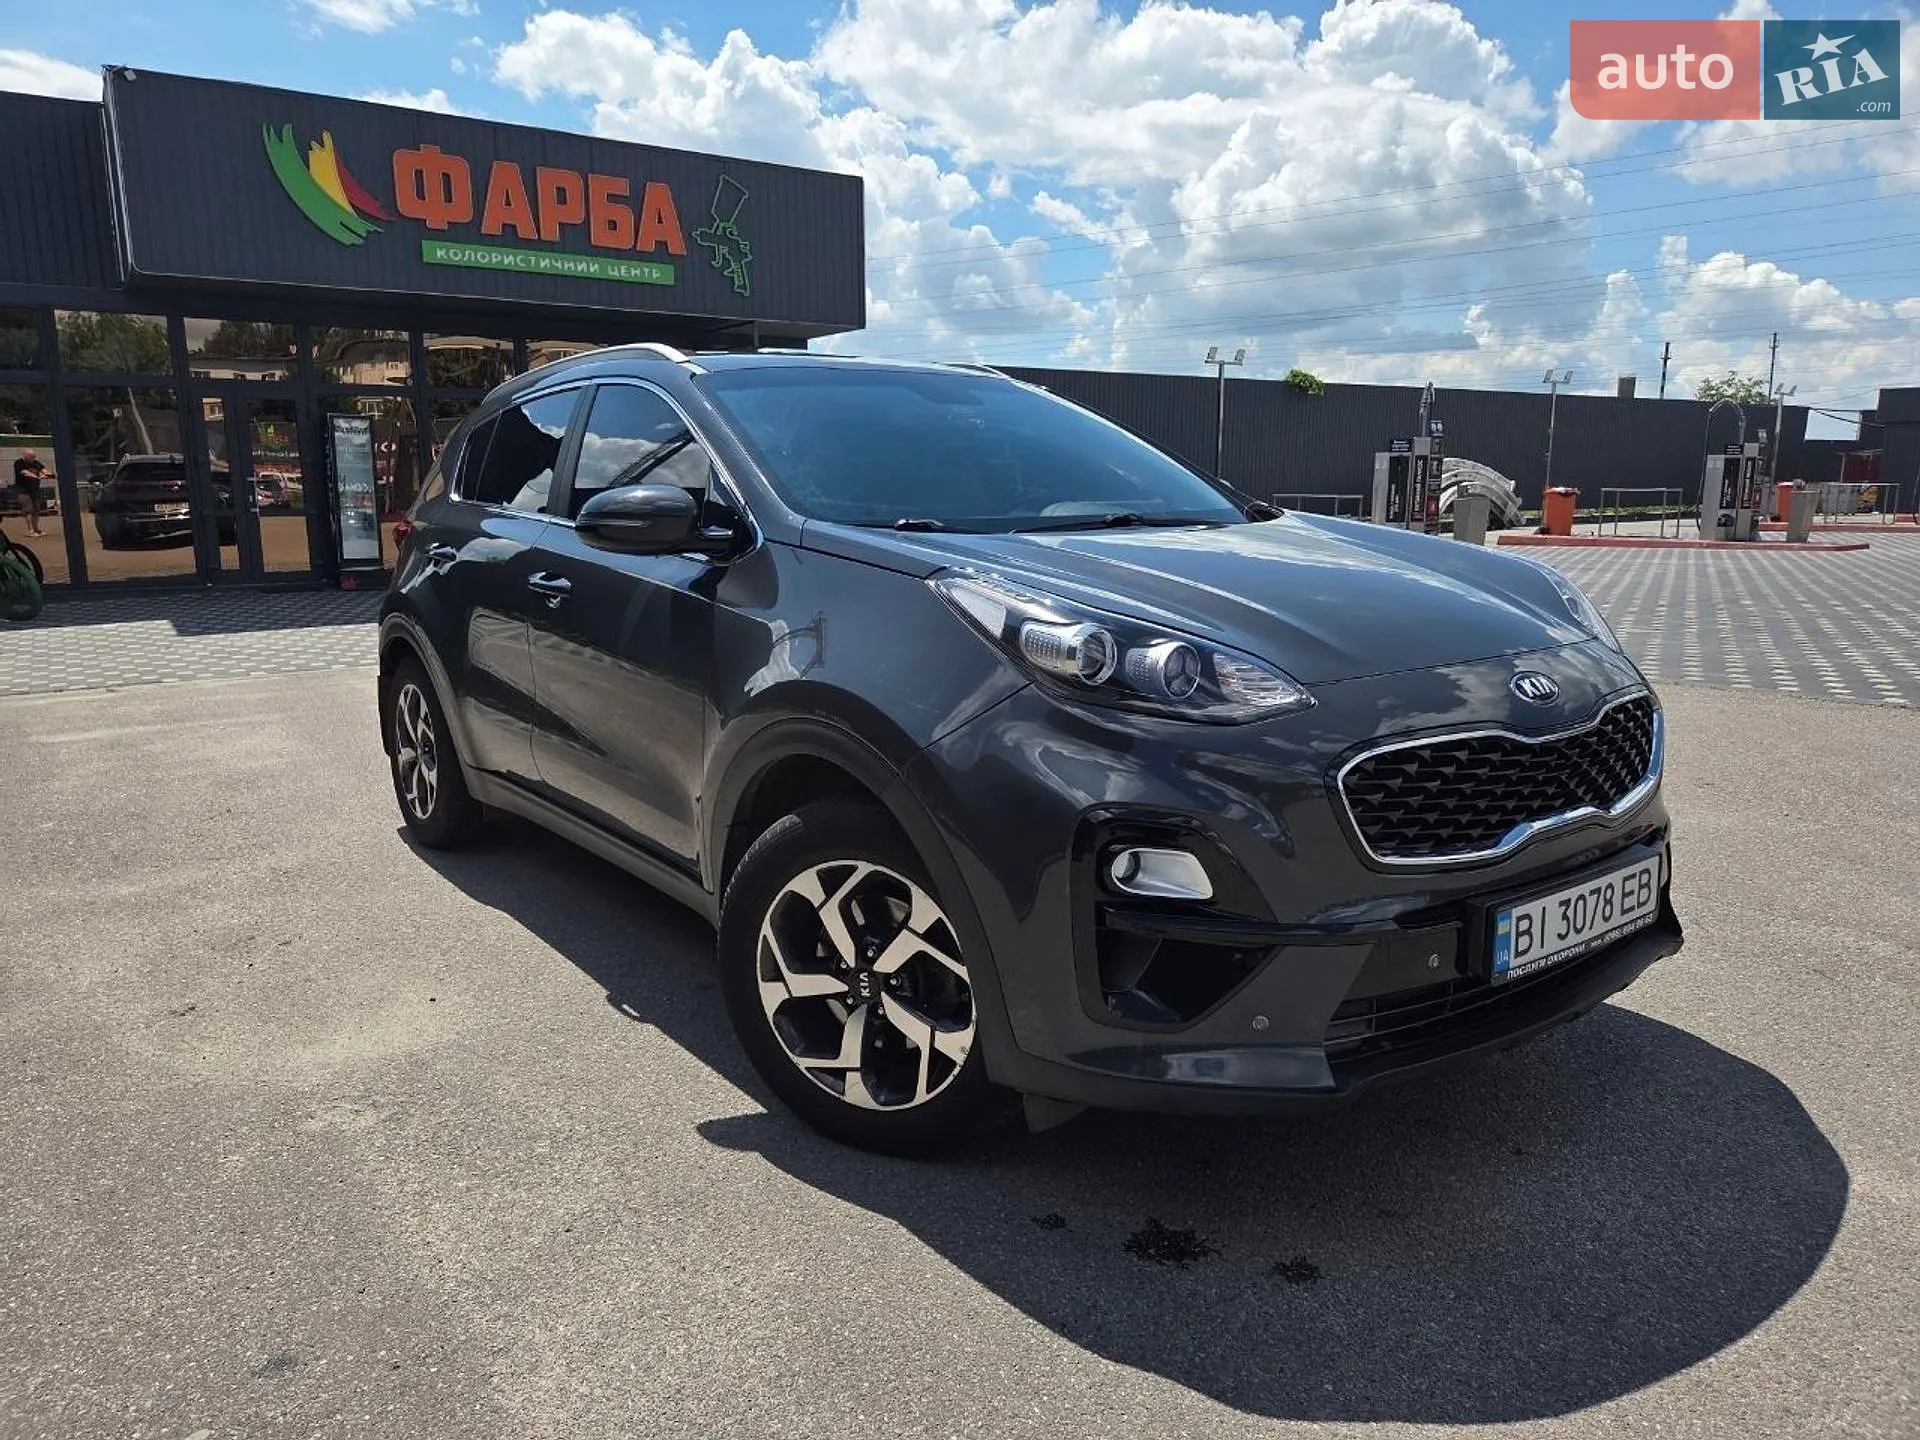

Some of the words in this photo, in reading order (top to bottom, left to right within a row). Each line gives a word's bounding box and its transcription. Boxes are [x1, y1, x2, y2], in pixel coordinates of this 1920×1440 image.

[393, 143, 687, 256] ФАРБА
[436, 247, 600, 274] КОЛОРИСТИЧНИЙ
[607, 264, 661, 279] ЦЕНТР
[1516, 676, 1556, 697] KIA
[1515, 906, 1546, 960] BI
[1557, 882, 1614, 941] 3078
[1620, 867, 1651, 916] EB
[859, 972, 870, 996] KIA
